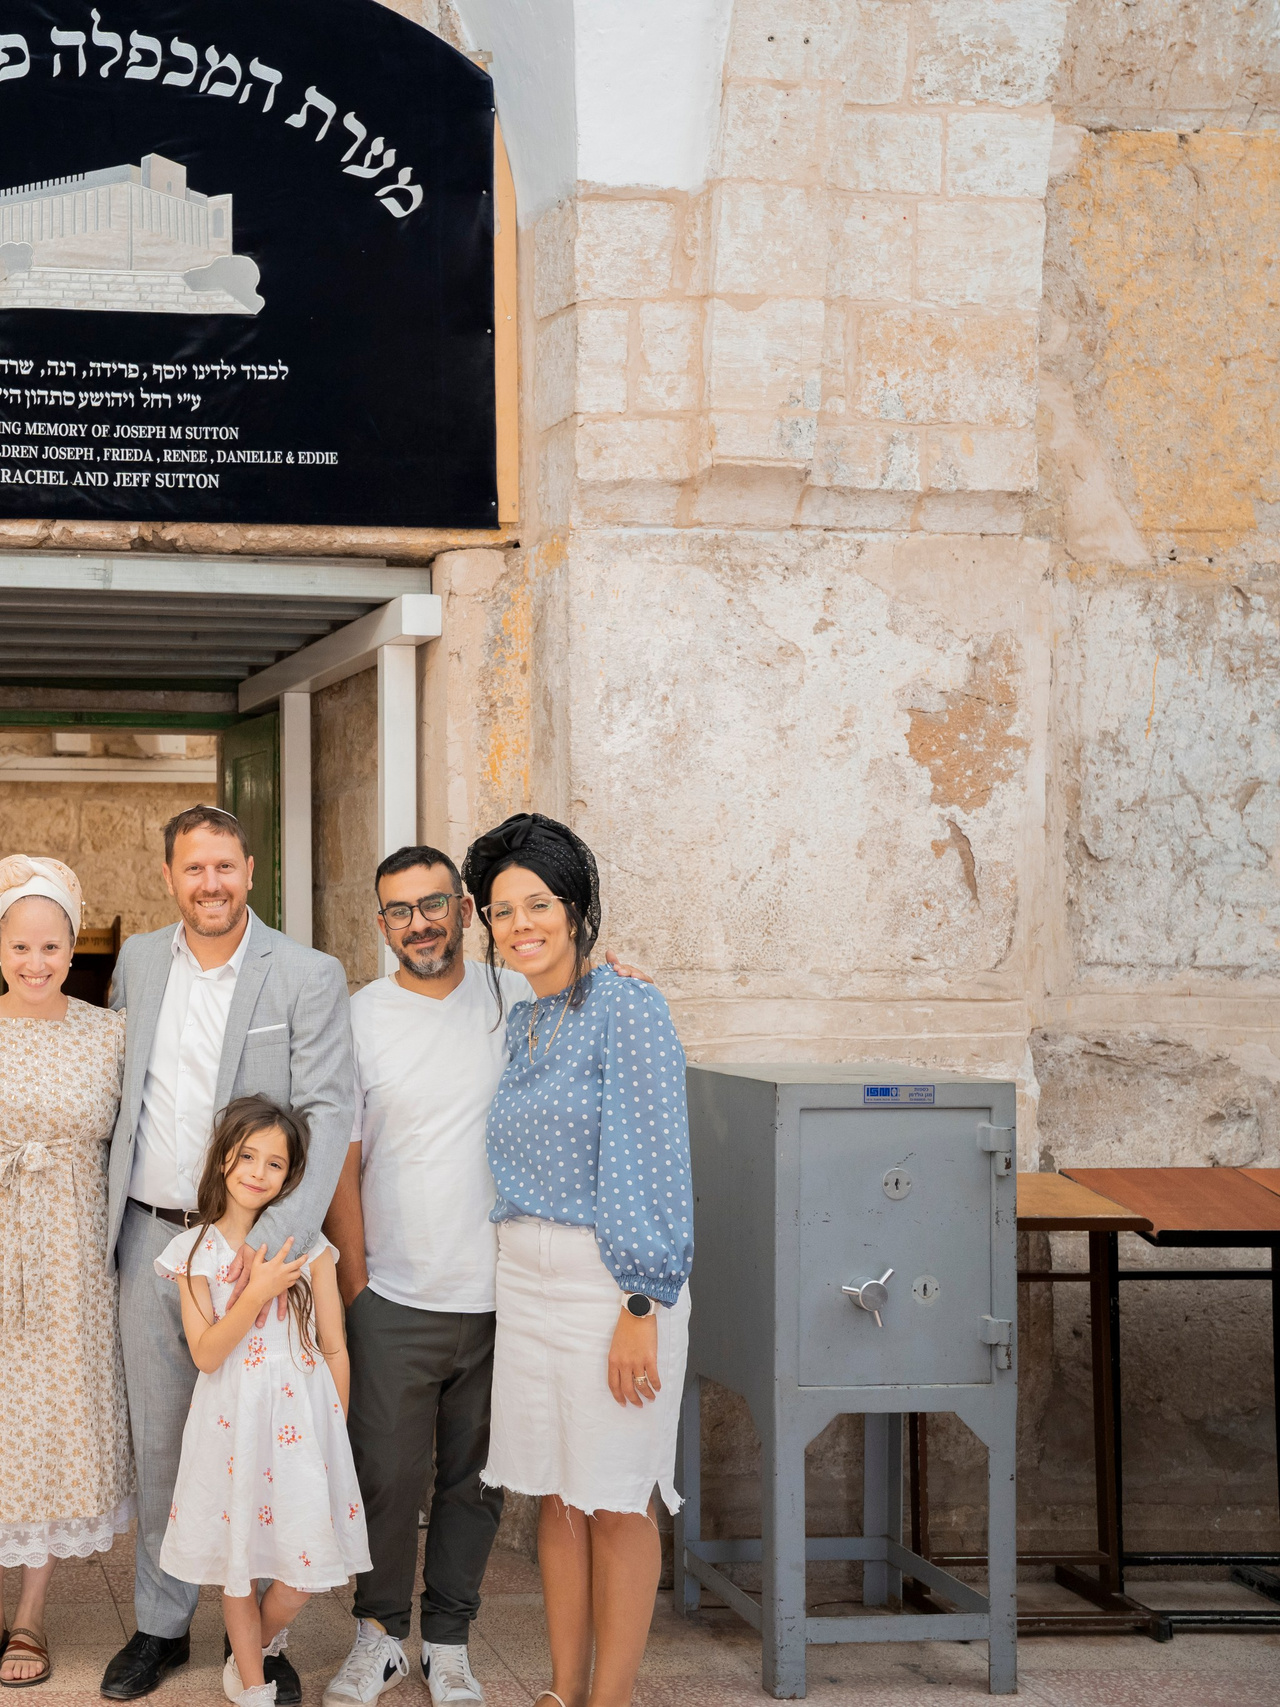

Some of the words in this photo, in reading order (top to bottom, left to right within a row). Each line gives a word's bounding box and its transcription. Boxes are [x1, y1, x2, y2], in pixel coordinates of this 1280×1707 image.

[50, 7, 283, 113] המכפלה
[285, 85, 424, 219] מערת
[192, 358, 237, 380] ילדינו
[240, 358, 289, 381] לכבוד
[139, 386, 172, 409] רחל
[24, 421, 89, 437] MEMORY
[91, 424, 111, 438] OF
[113, 424, 167, 439] JOSEPH
[169, 426, 183, 439] M
[185, 426, 240, 441] SUTTON
[216, 449, 283, 464] DANIELLE
[285, 450, 295, 464] &
[297, 451, 339, 465] EDDIE
[0, 468, 69, 486] RACHEL
[71, 471, 109, 487] AND
[112, 472, 152, 488] JEFF
[155, 472, 220, 489] SUTTON
